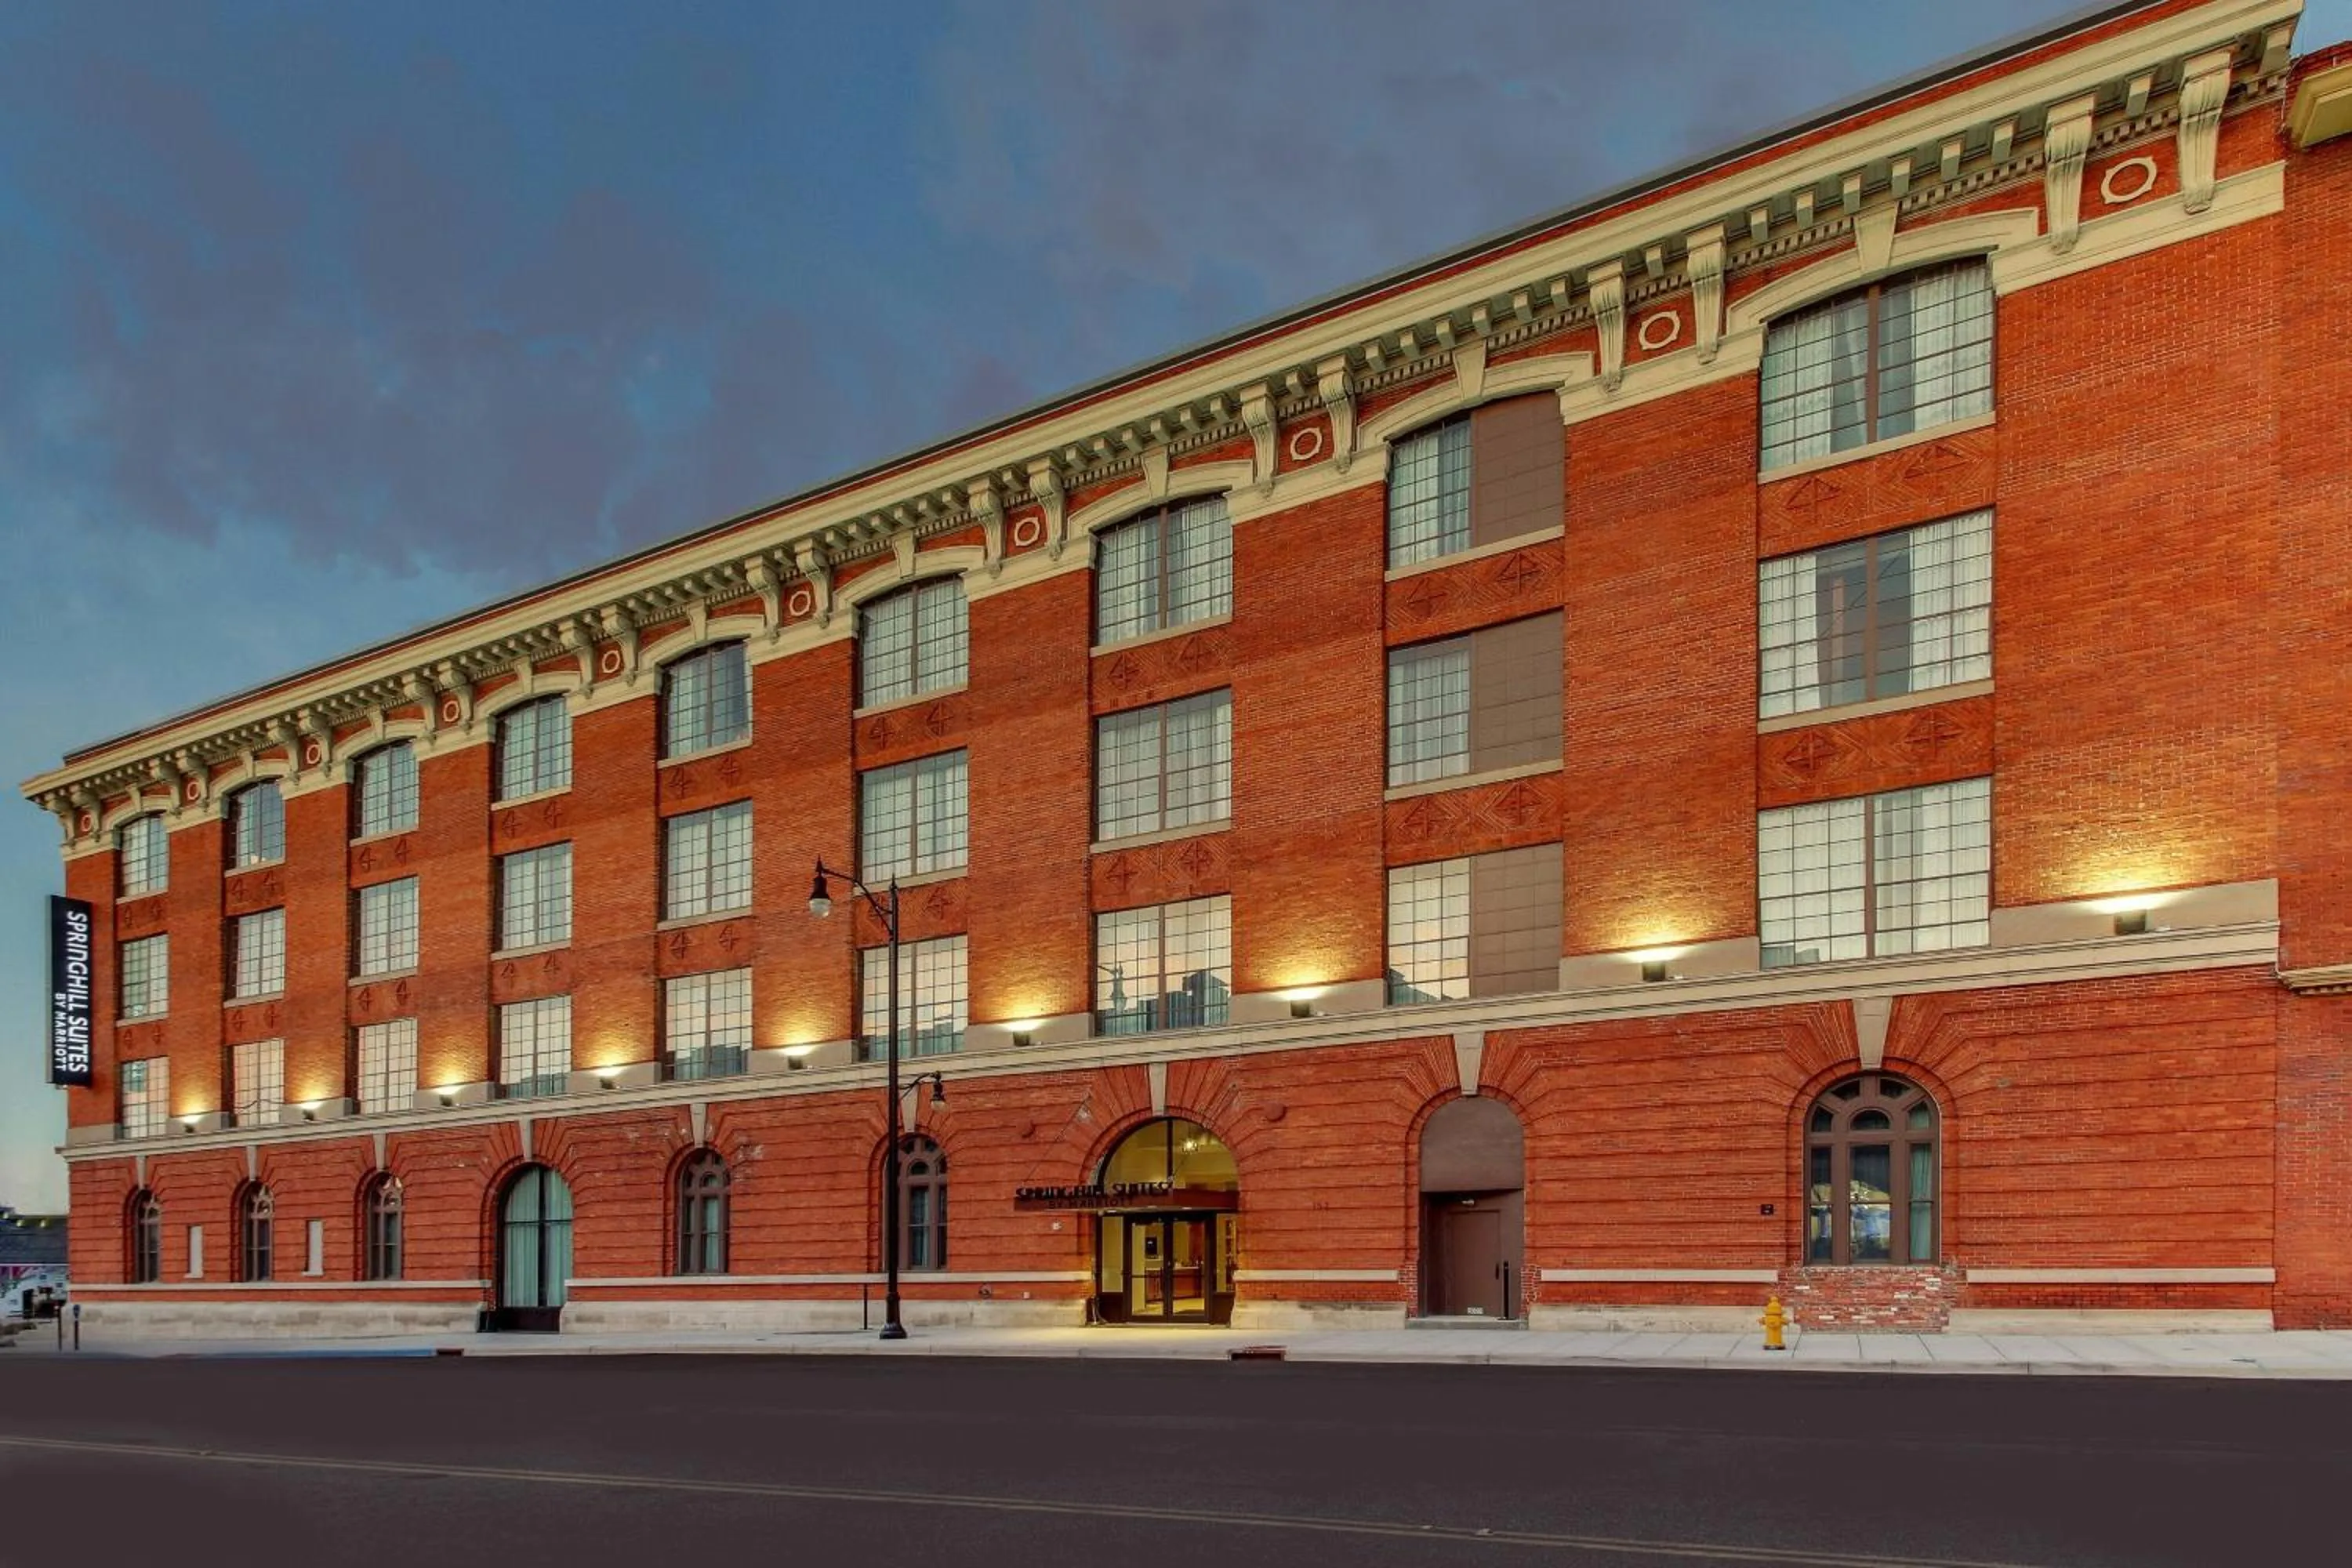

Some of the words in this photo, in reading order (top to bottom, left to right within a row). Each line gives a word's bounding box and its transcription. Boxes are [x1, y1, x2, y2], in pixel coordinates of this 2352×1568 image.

[66, 910, 89, 1011] SPRINGHILL
[55, 993, 67, 1008] BY
[55, 1011, 67, 1071] MARRIOTT
[68, 1016, 89, 1073] SUITES
